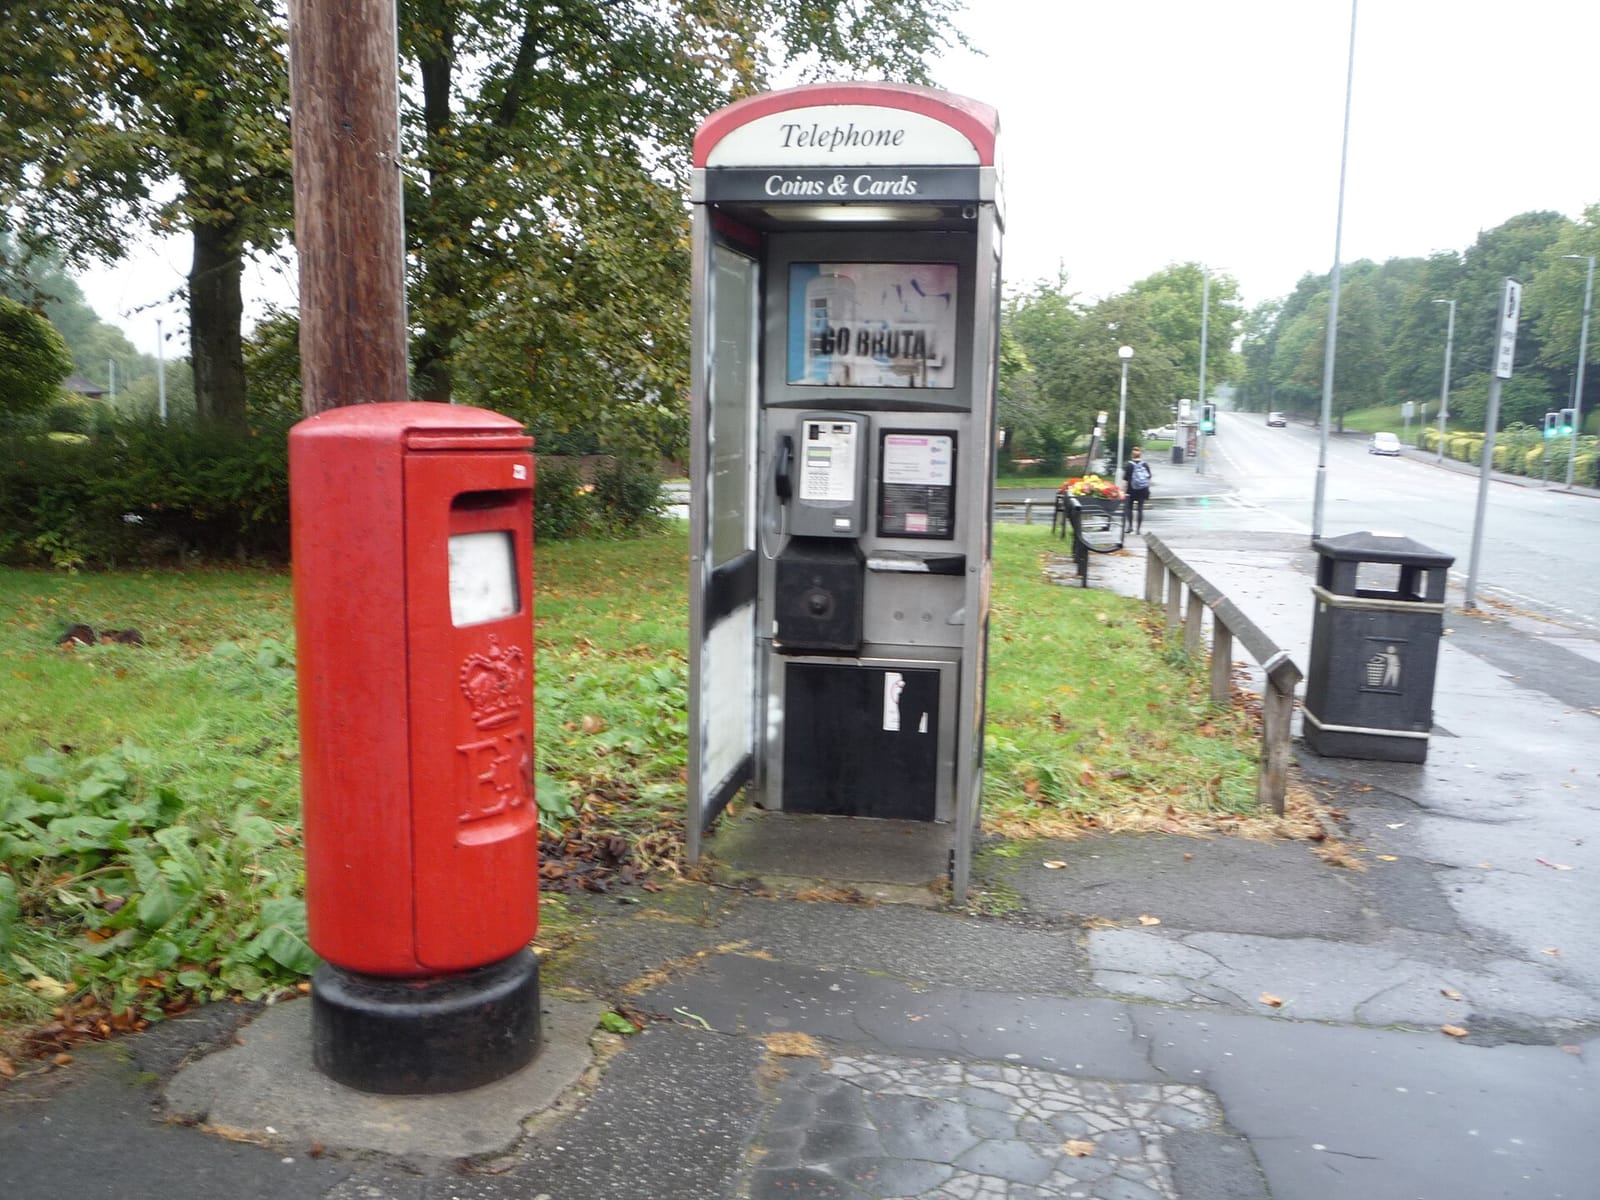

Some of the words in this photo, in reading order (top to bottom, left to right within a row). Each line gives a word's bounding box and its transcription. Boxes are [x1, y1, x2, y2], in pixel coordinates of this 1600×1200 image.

[780, 123, 905, 152] Telephone
[764, 174, 825, 197] Coins
[827, 175, 850, 197] &
[852, 174, 917, 196] Cards
